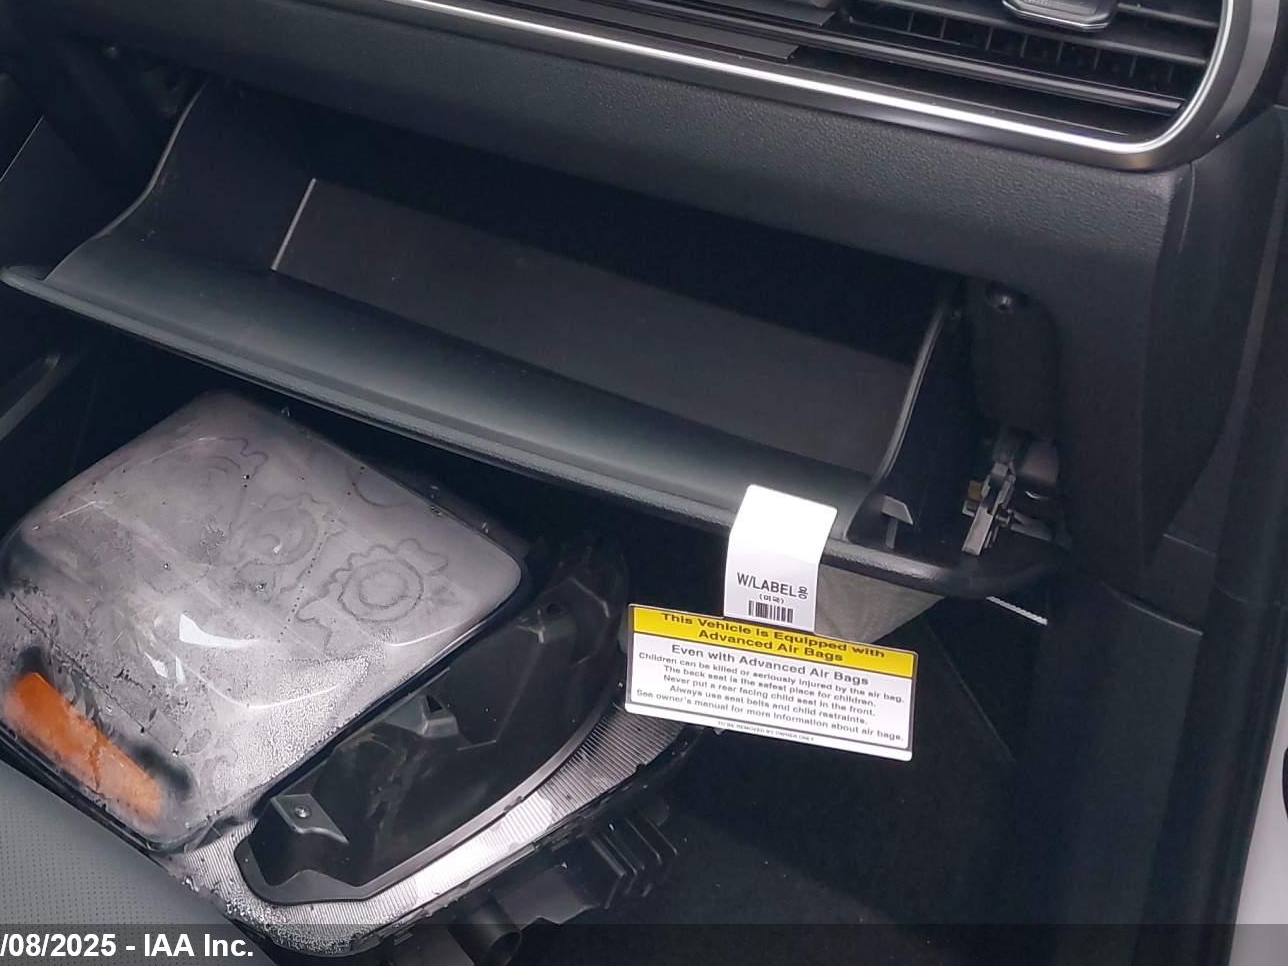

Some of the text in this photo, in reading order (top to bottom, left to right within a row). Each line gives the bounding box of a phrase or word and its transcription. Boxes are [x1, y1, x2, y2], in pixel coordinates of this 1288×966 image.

[736, 571, 809, 600] W/LABEL용
[661, 612, 886, 659] This Vehicle is Equipped with
[698, 629, 844, 662] Advanced Air Bags
[638, 651, 905, 704] Children can be killed or seriously injured by the air bag.
[663, 664, 877, 707] The back seat is the safest place for children.
[671, 644, 869, 686] Even with Advanced Air Bags
[636, 689, 904, 742] See owner's manual for more information about air bags.
[663, 674, 690, 685] Never
[692, 679, 708, 689] put
[718, 684, 737, 693] rear
[740, 686, 768, 699] facing
[770, 692, 794, 703] child
[797, 696, 817, 707] seat
[819, 699, 828, 708] in
[831, 702, 847, 712] the
[849, 705, 876, 716] front.
[669, 685, 868, 725] Always use seat belts and child restraints.
